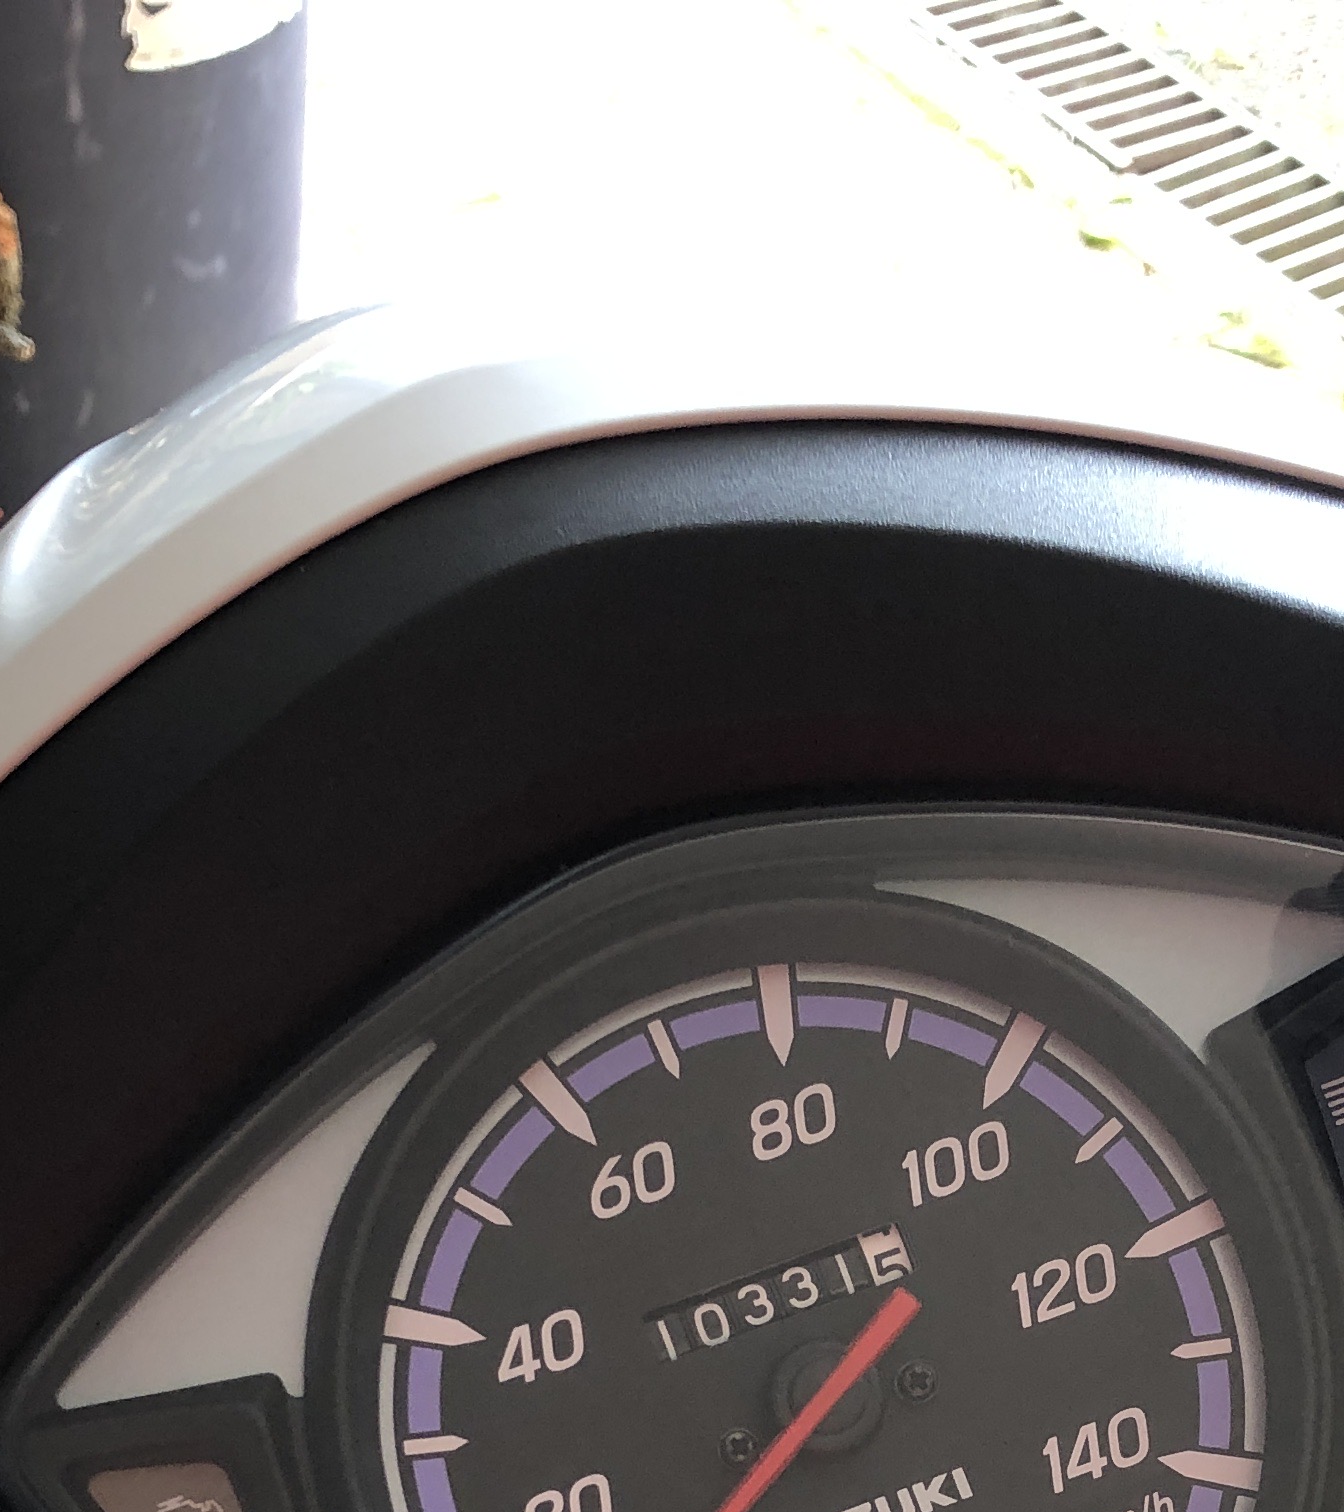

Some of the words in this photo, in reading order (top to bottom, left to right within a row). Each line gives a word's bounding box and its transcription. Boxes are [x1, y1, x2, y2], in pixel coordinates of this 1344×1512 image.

[749, 1082, 838, 1162] 80
[901, 1120, 1012, 1207] 100
[588, 1140, 677, 1220] 60
[1010, 1242, 1119, 1329] 120
[496, 1308, 586, 1386] 40
[1042, 1407, 1151, 1495] 140
